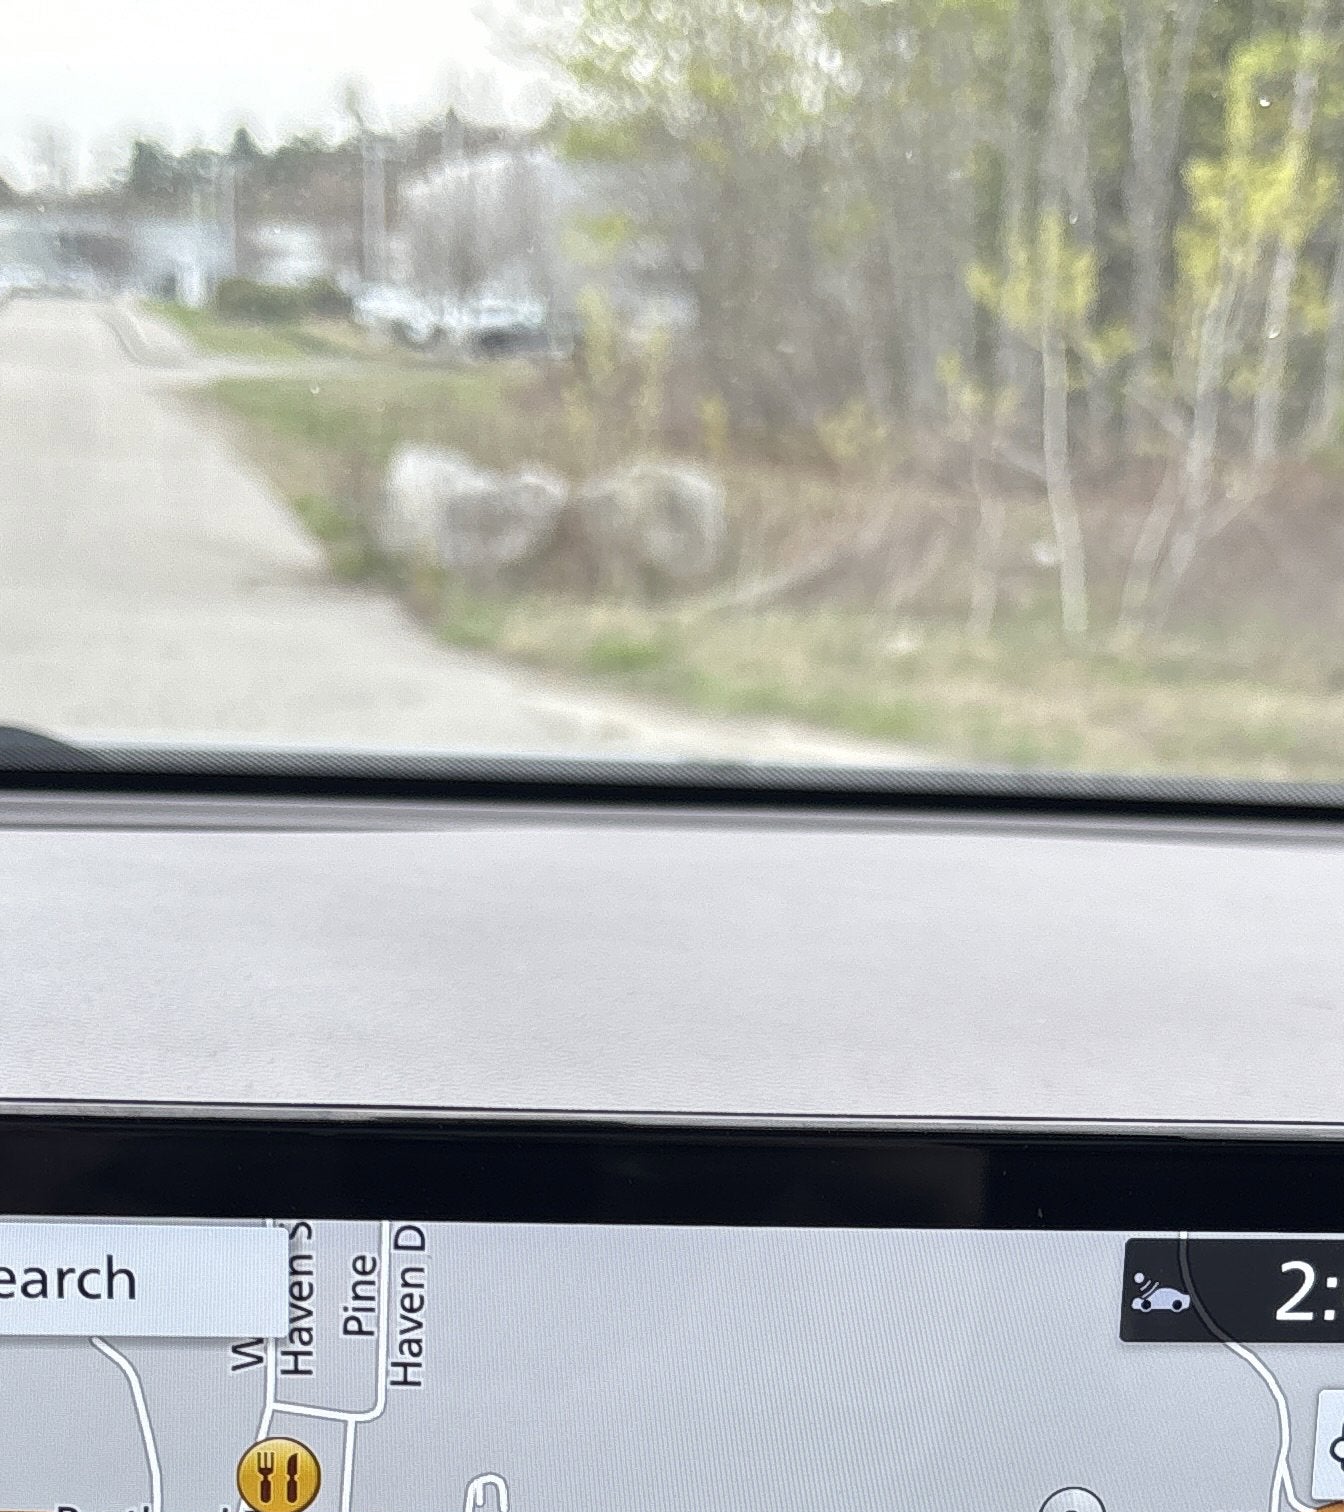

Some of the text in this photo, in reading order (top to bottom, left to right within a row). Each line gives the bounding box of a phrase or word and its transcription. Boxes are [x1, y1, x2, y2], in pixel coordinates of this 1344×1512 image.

[280, 1254, 314, 1376] Haven
[342, 1254, 377, 1337] Pine
[389, 1266, 425, 1387] Haven
